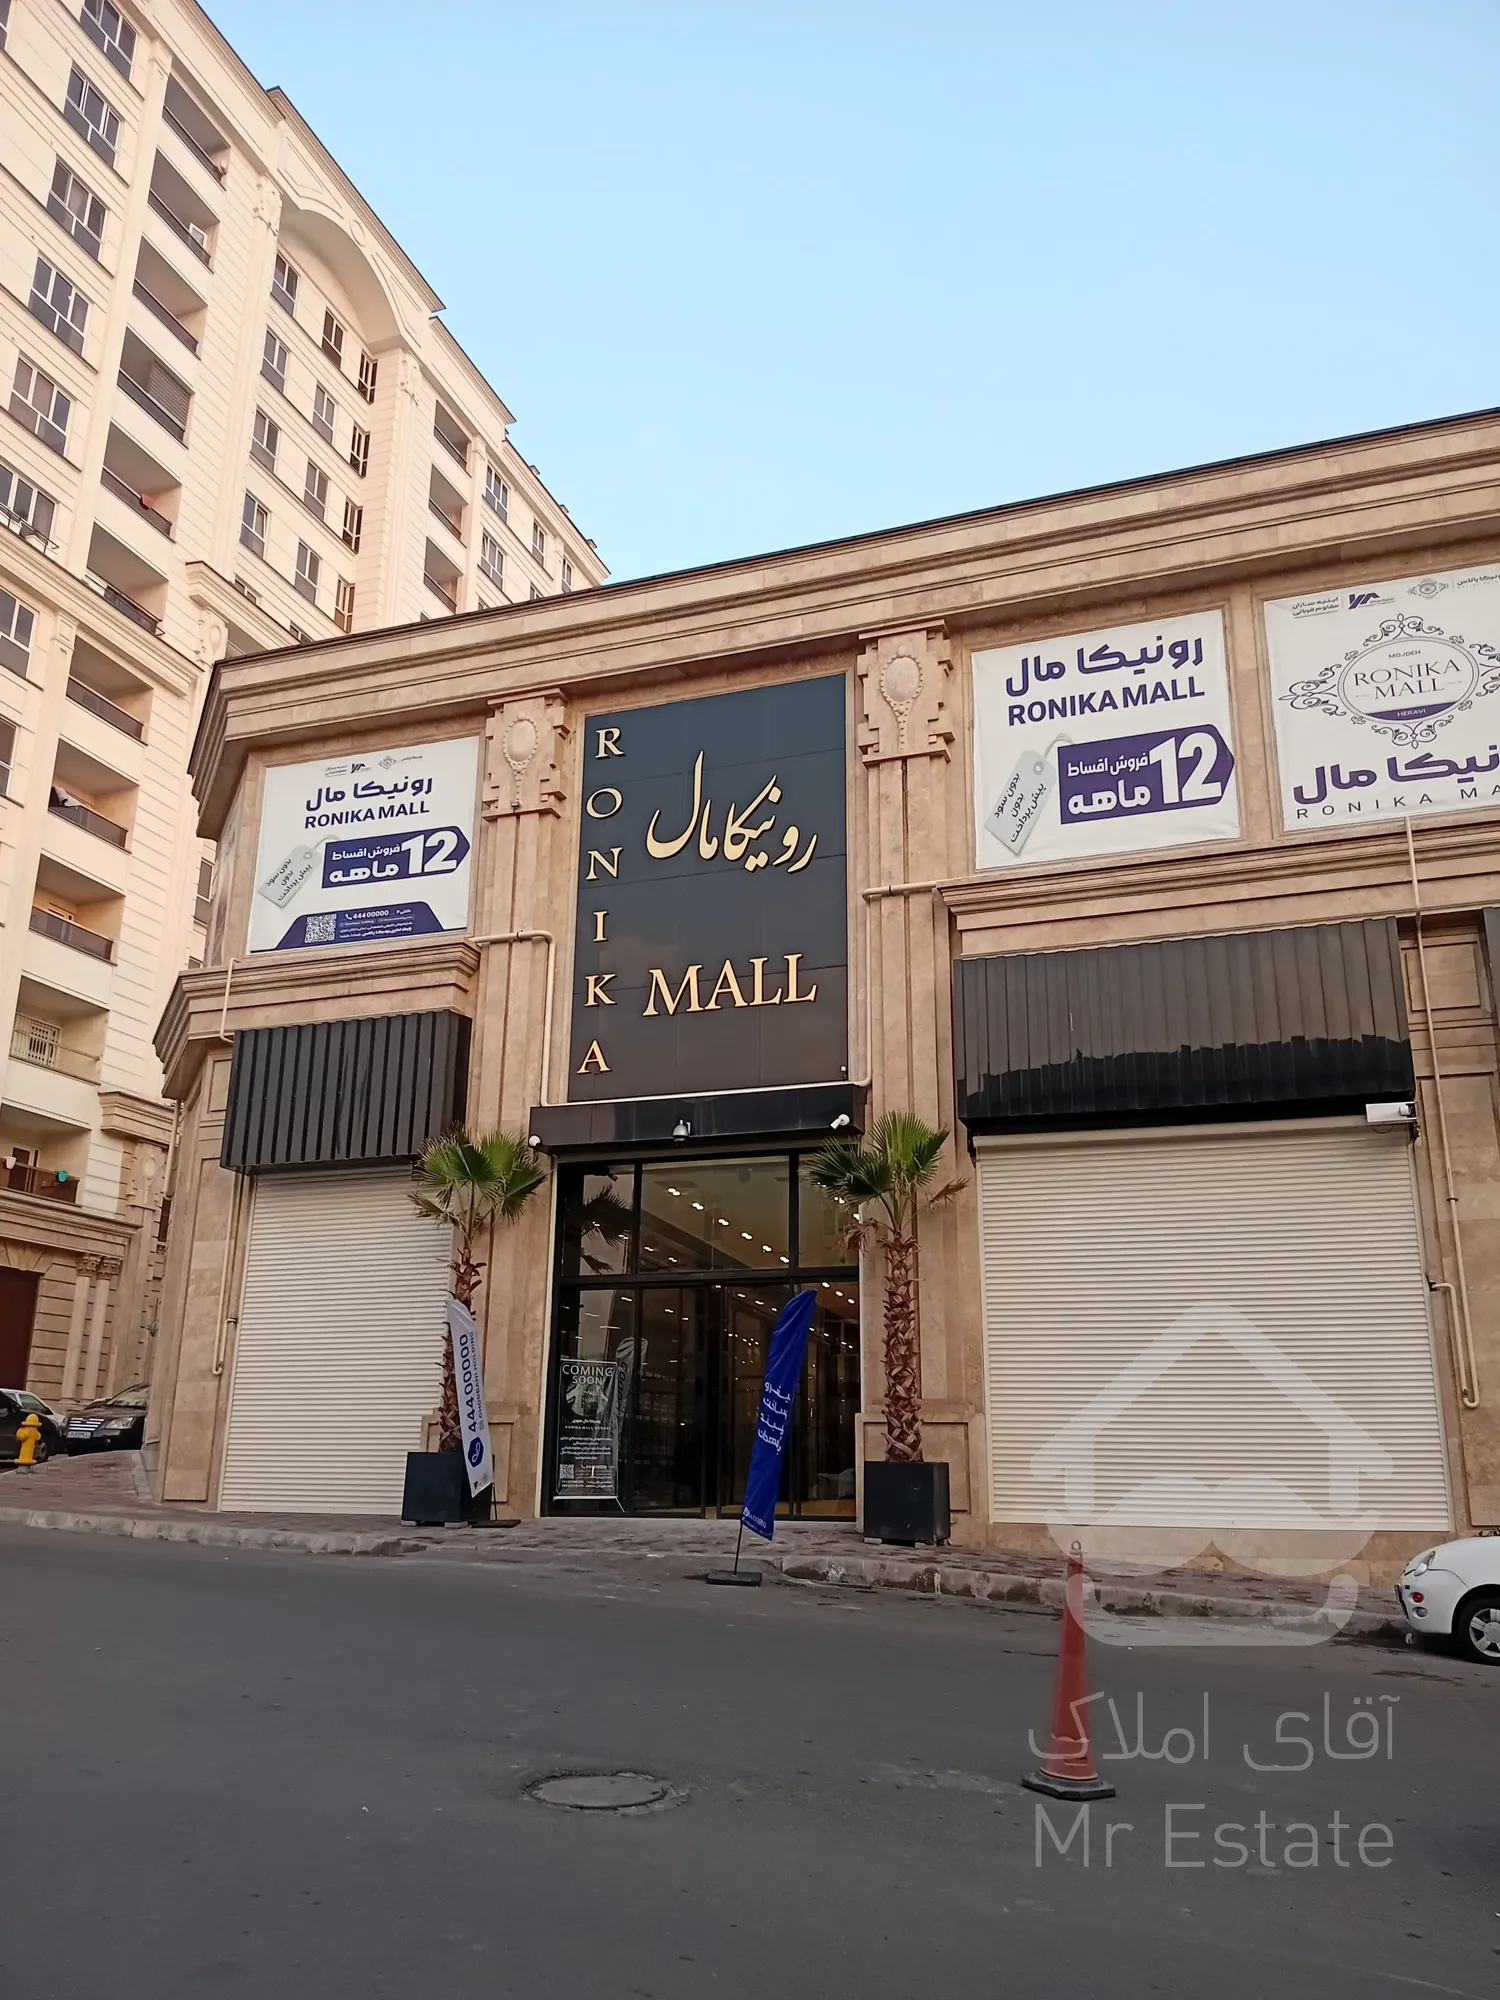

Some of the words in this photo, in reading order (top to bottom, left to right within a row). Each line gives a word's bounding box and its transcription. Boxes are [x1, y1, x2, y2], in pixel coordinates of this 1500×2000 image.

[1077, 635, 1204, 675] رونیکا
[1389, 650, 1421, 659] MOJDEH
[1005, 655, 1066, 697] مال
[1354, 659, 1461, 687] RONIKA
[1375, 678, 1444, 699] MALL
[1008, 690, 1118, 727] RONIKA
[1122, 676, 1205, 708] MALL
[1397, 708, 1426, 717] HERAVI
[1067, 758, 1108, 777] اقساط
[1110, 753, 1148, 776] فروش
[1148, 732, 1222, 804] 12
[353, 776, 433, 799] رونیکا
[1007, 773, 1021, 798] بدون
[1031, 783, 1047, 809] پیش
[1068, 779, 1151, 815] ماهه
[1293, 764, 1377, 805] مال
[306, 787, 346, 811] مال
[994, 796, 1008, 818] سود
[1011, 793, 1025, 818] بدون
[1296, 793, 1433, 820] RONIKA
[305, 808, 376, 829] RONIKA
[378, 801, 430, 819] MALL
[723, 774, 818, 873] رونیکا
[1011, 808, 1034, 843] پرداخت
[332, 848, 367, 860] اقساط
[368, 844, 401, 858] فروش
[401, 830, 459, 875] 12
[279, 859, 292, 874] بدون
[281, 870, 294, 886] بدون
[329, 860, 399, 883] ماهه
[266, 873, 280, 887] سود
[577, 727, 624, 1074] RONIKA
[643, 953, 818, 1016] MALL
[562, 1364, 614, 1377] COMING
[460, 1334, 477, 1433] 44400000
